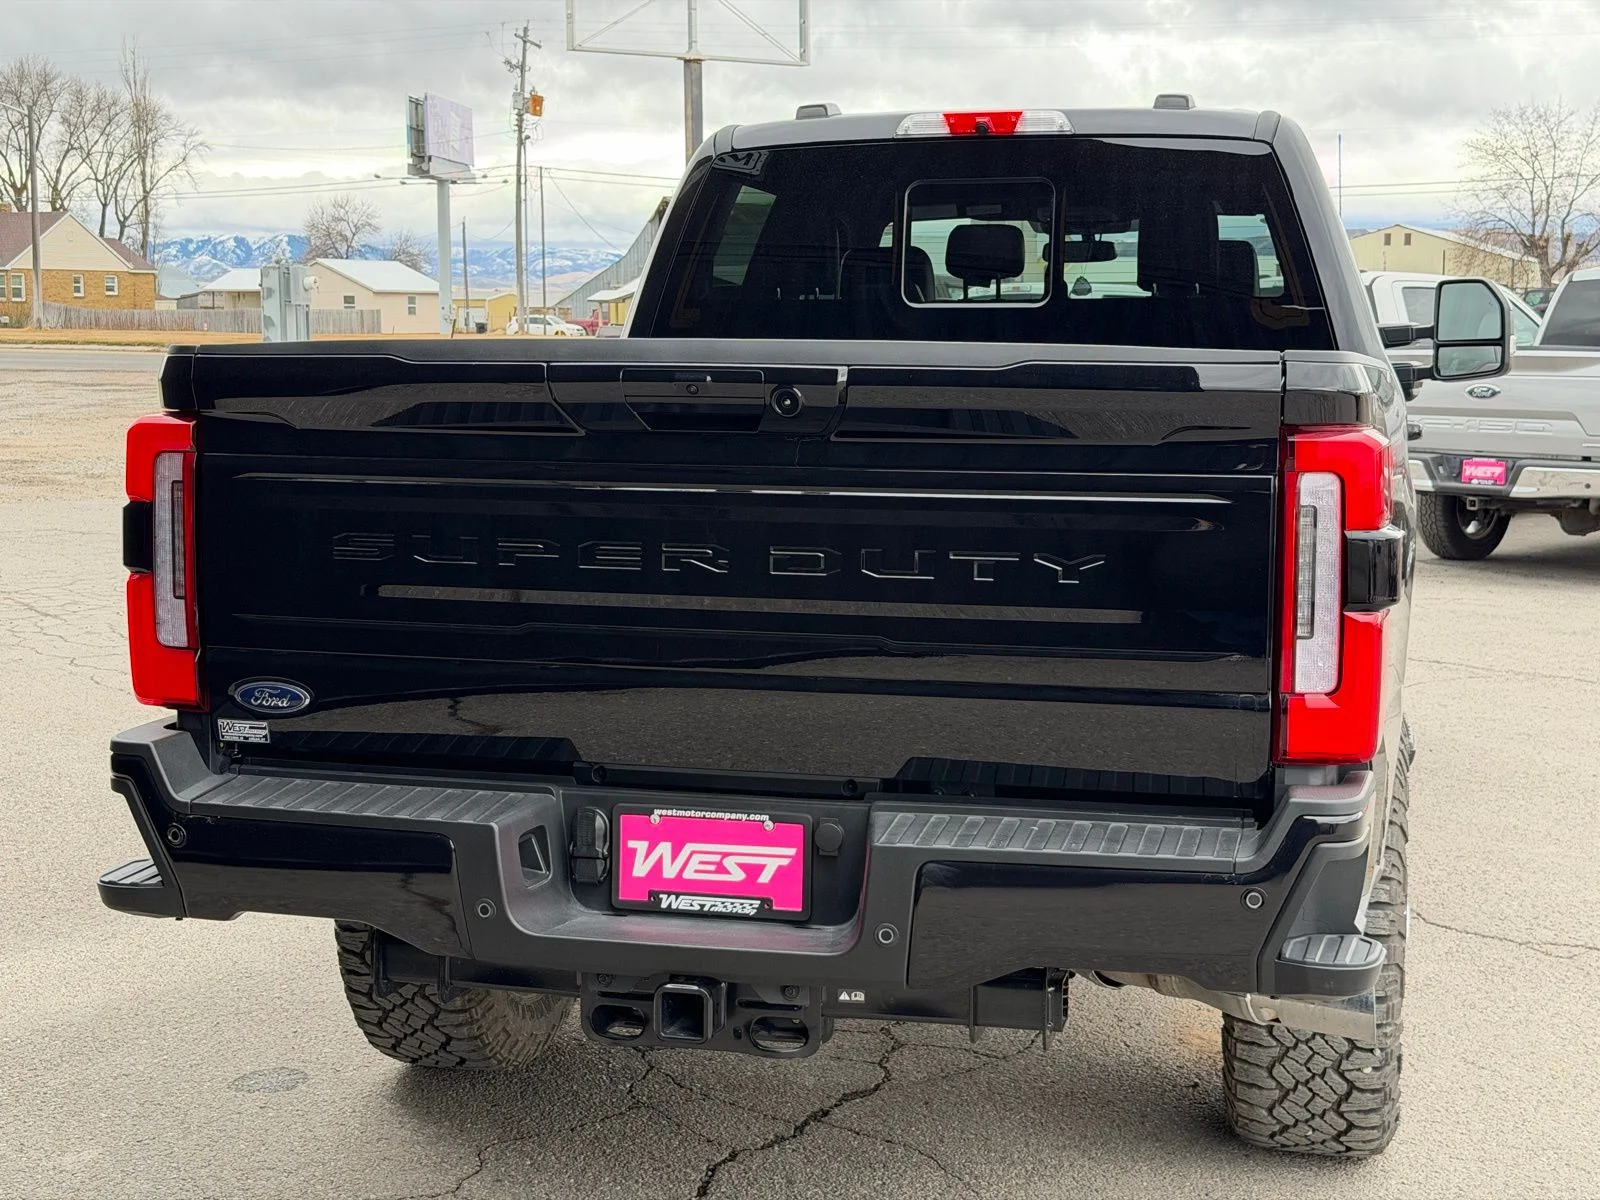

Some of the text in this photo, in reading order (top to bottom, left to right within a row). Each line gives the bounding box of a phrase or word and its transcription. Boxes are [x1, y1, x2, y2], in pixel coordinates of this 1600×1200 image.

[1464, 465, 1504, 478] WEST
[333, 532, 1106, 583] SUPER DUTY
[251, 688, 291, 707] Ford
[653, 808, 770, 821] westmotorcompany.com
[627, 840, 797, 883] WEST
[659, 894, 760, 912] WEST
